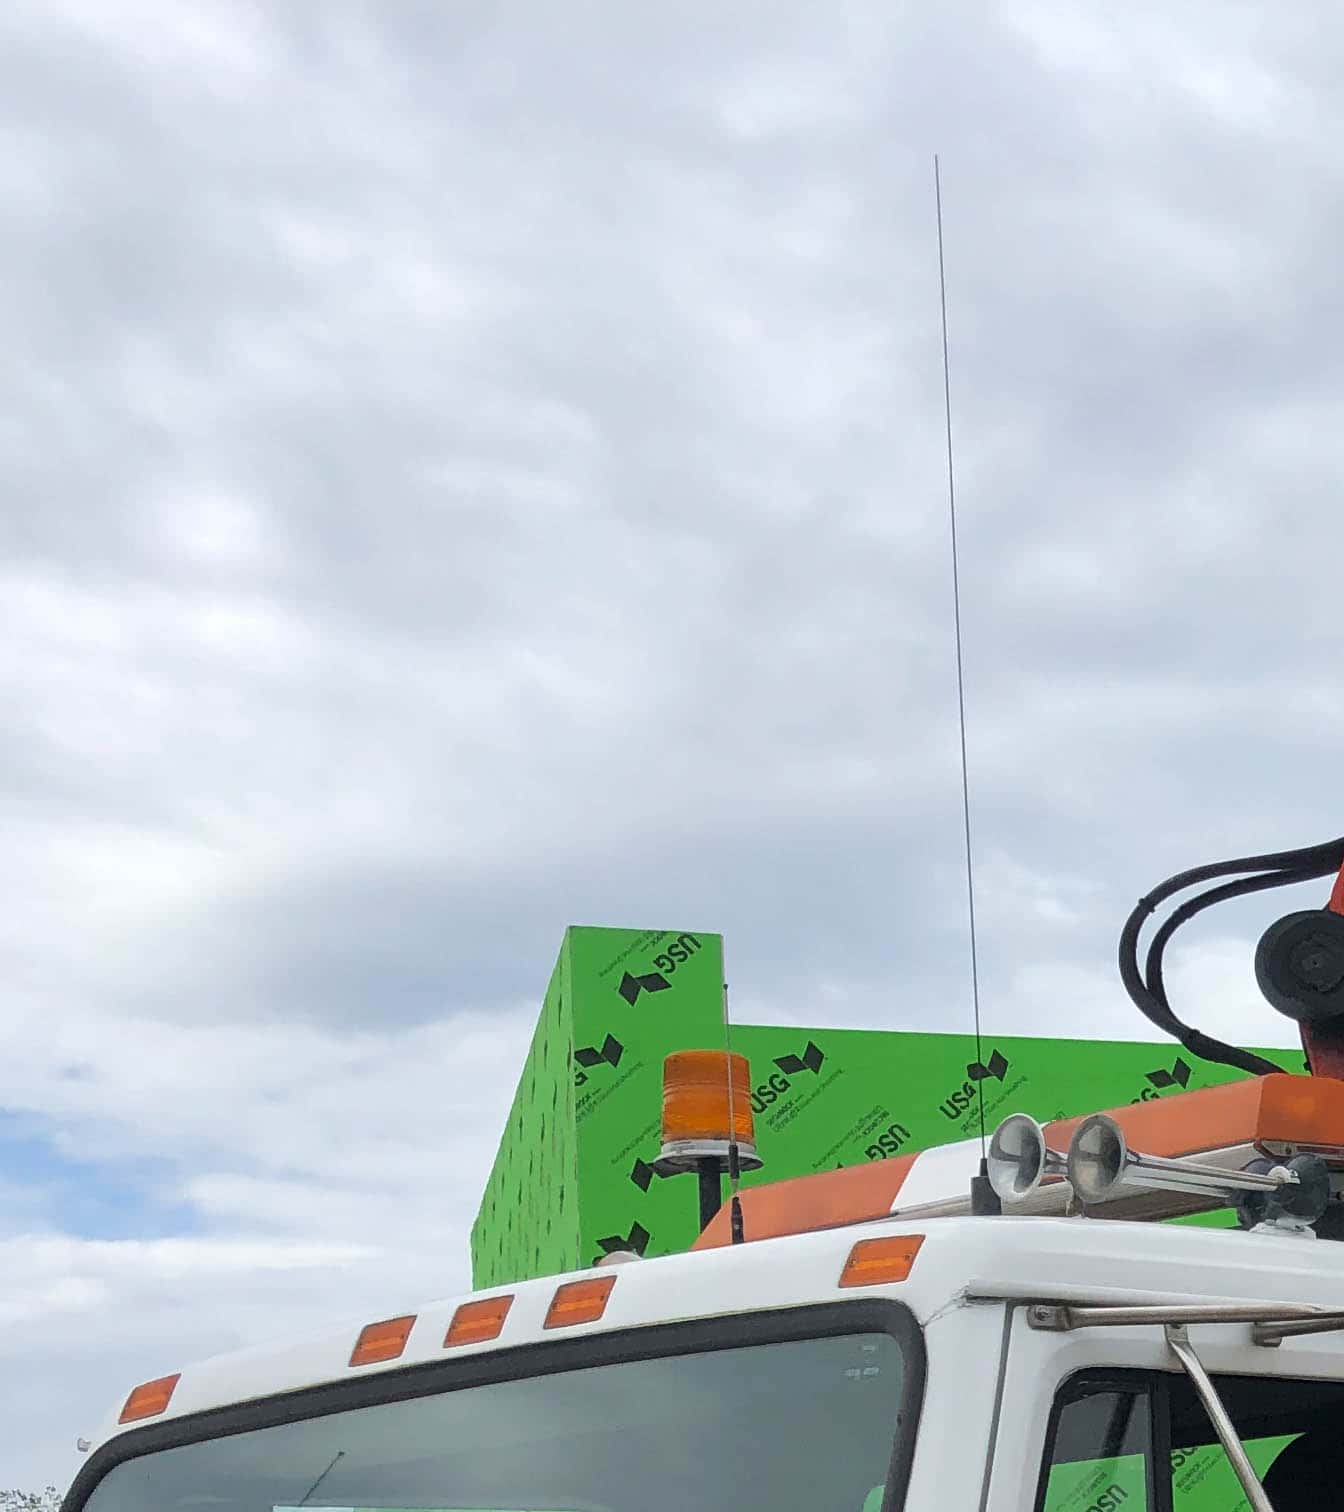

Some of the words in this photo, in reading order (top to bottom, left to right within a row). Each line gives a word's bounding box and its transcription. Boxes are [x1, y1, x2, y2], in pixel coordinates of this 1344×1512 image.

[652, 933, 702, 974] USG
[750, 1073, 792, 1114] USG
[938, 1081, 977, 1121] USG
[864, 1124, 912, 1160] USG
